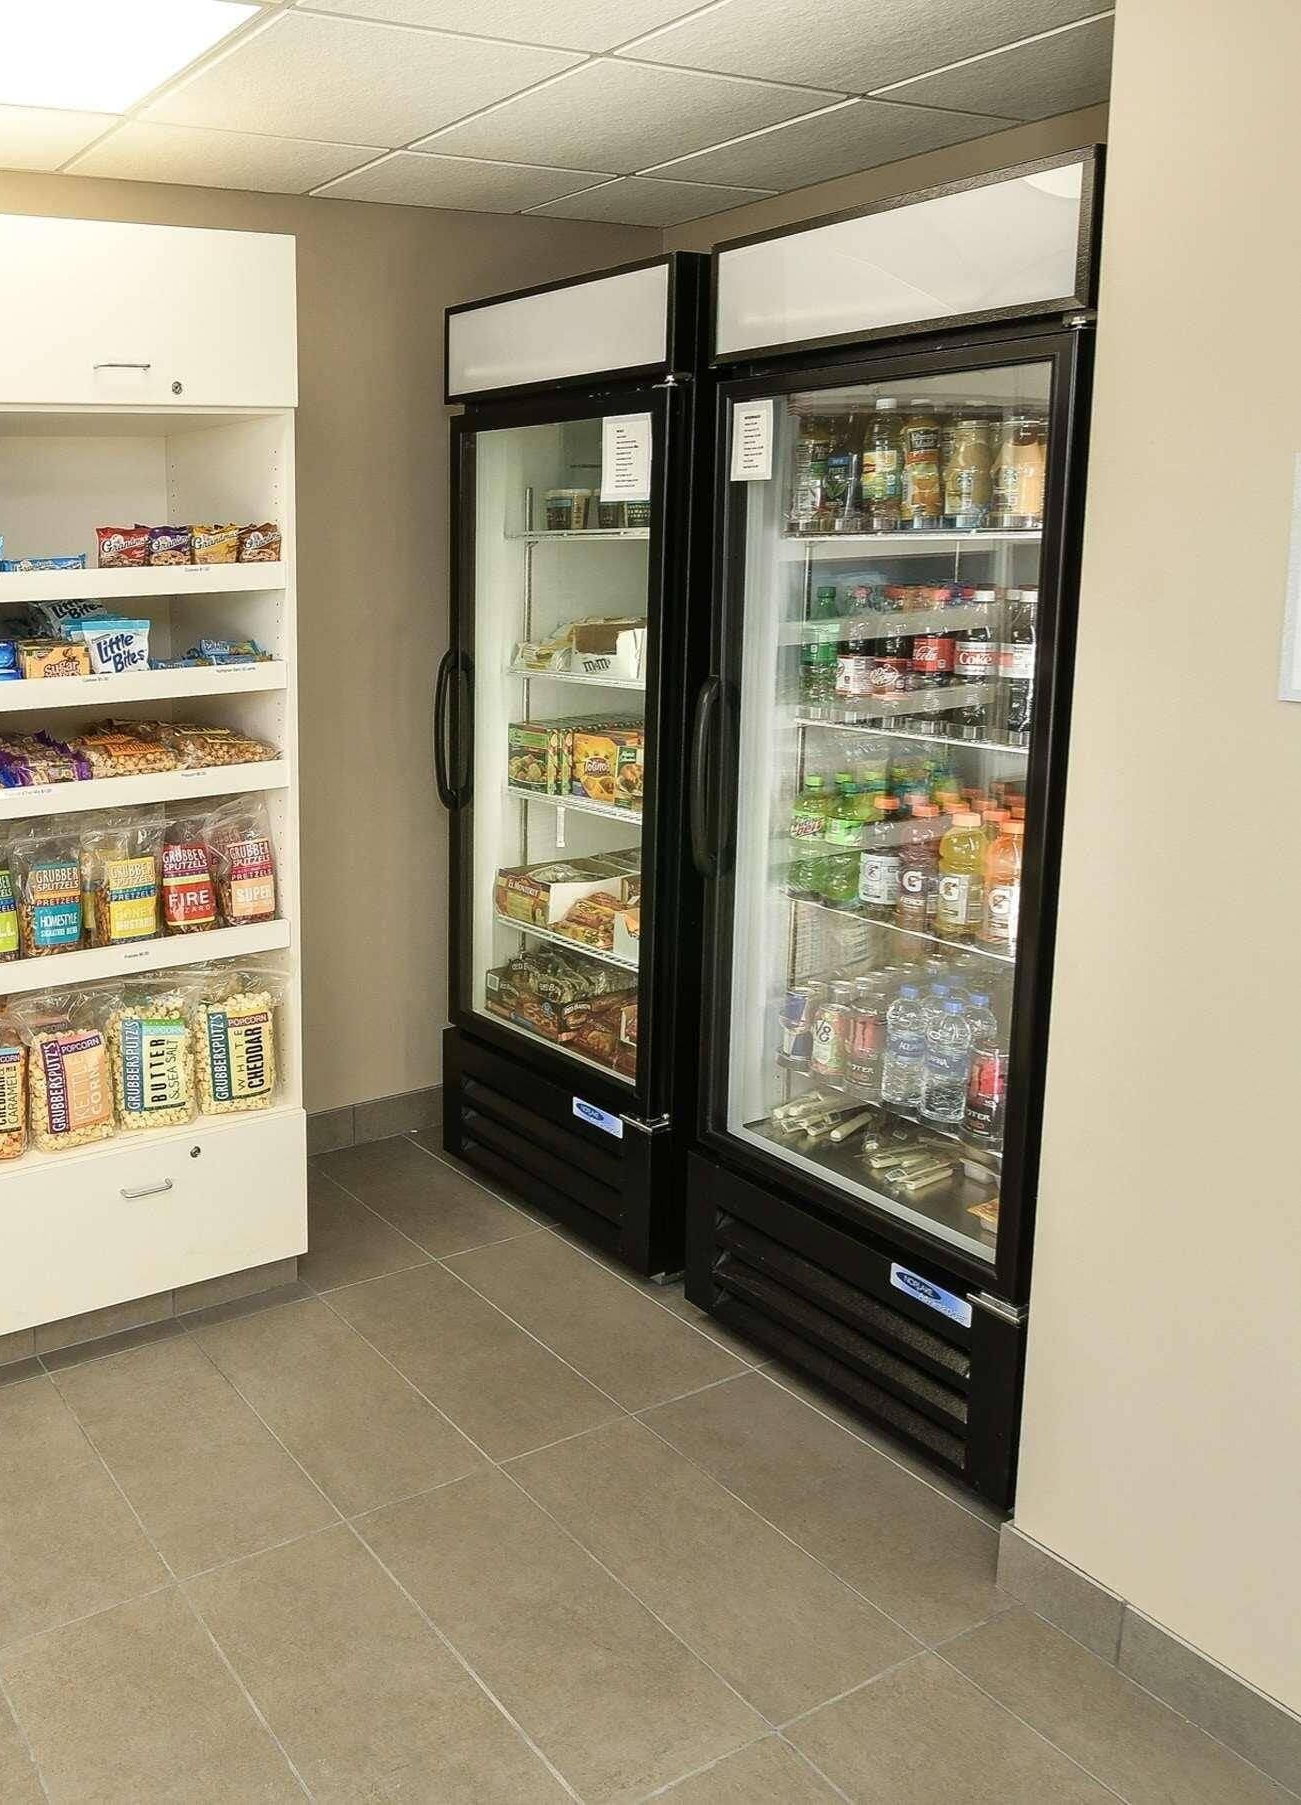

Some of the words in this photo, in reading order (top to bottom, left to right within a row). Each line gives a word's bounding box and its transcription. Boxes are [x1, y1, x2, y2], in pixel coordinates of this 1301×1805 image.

[97, 633, 134, 664] Little
[959, 652, 992, 665] Coke
[113, 649, 146, 673] Bites
[37, 896, 80, 906] PRETZELS
[169, 890, 209, 907] FIRE
[229, 1014, 268, 1027] POPCORN
[61, 1038, 100, 1053] POPCORN
[166, 1040, 178, 1064] SALT
[244, 1026, 265, 1089] CHEDDAR
[150, 1038, 168, 1103] BUTTER
[233, 1029, 246, 1091] WHITE
[167, 1066, 180, 1088] SEA
[6, 1074, 19, 1124] CARAMEL
